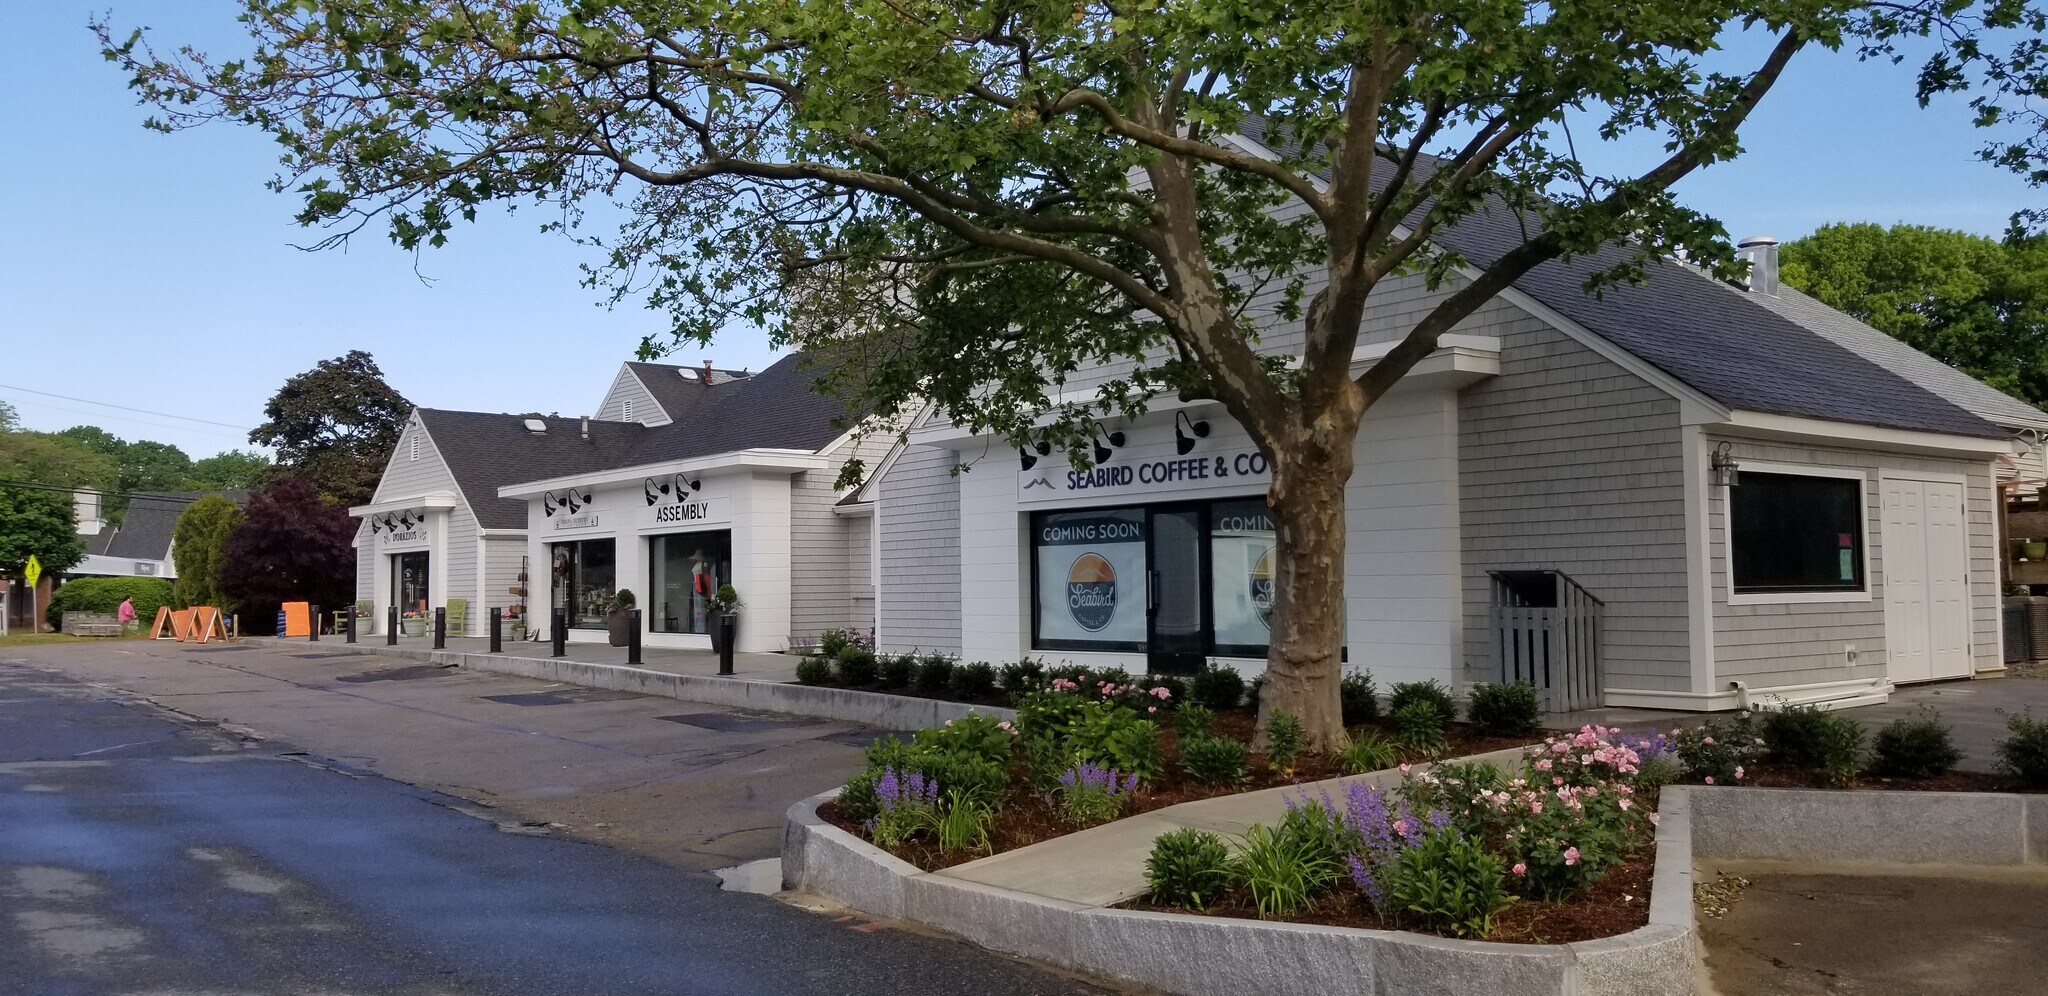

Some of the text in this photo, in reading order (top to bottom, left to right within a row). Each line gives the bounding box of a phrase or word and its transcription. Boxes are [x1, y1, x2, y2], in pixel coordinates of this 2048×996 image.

[1067, 465, 1133, 490] SEABIRD
[1139, 457, 1209, 484] COFFEE
[1213, 456, 1228, 478] &
[656, 502, 708, 523] ASSEMBLY
[1043, 522, 1140, 541] COMING SOON
[1220, 515, 1275, 533] COMIN
[1070, 583, 1114, 609] Seabird
